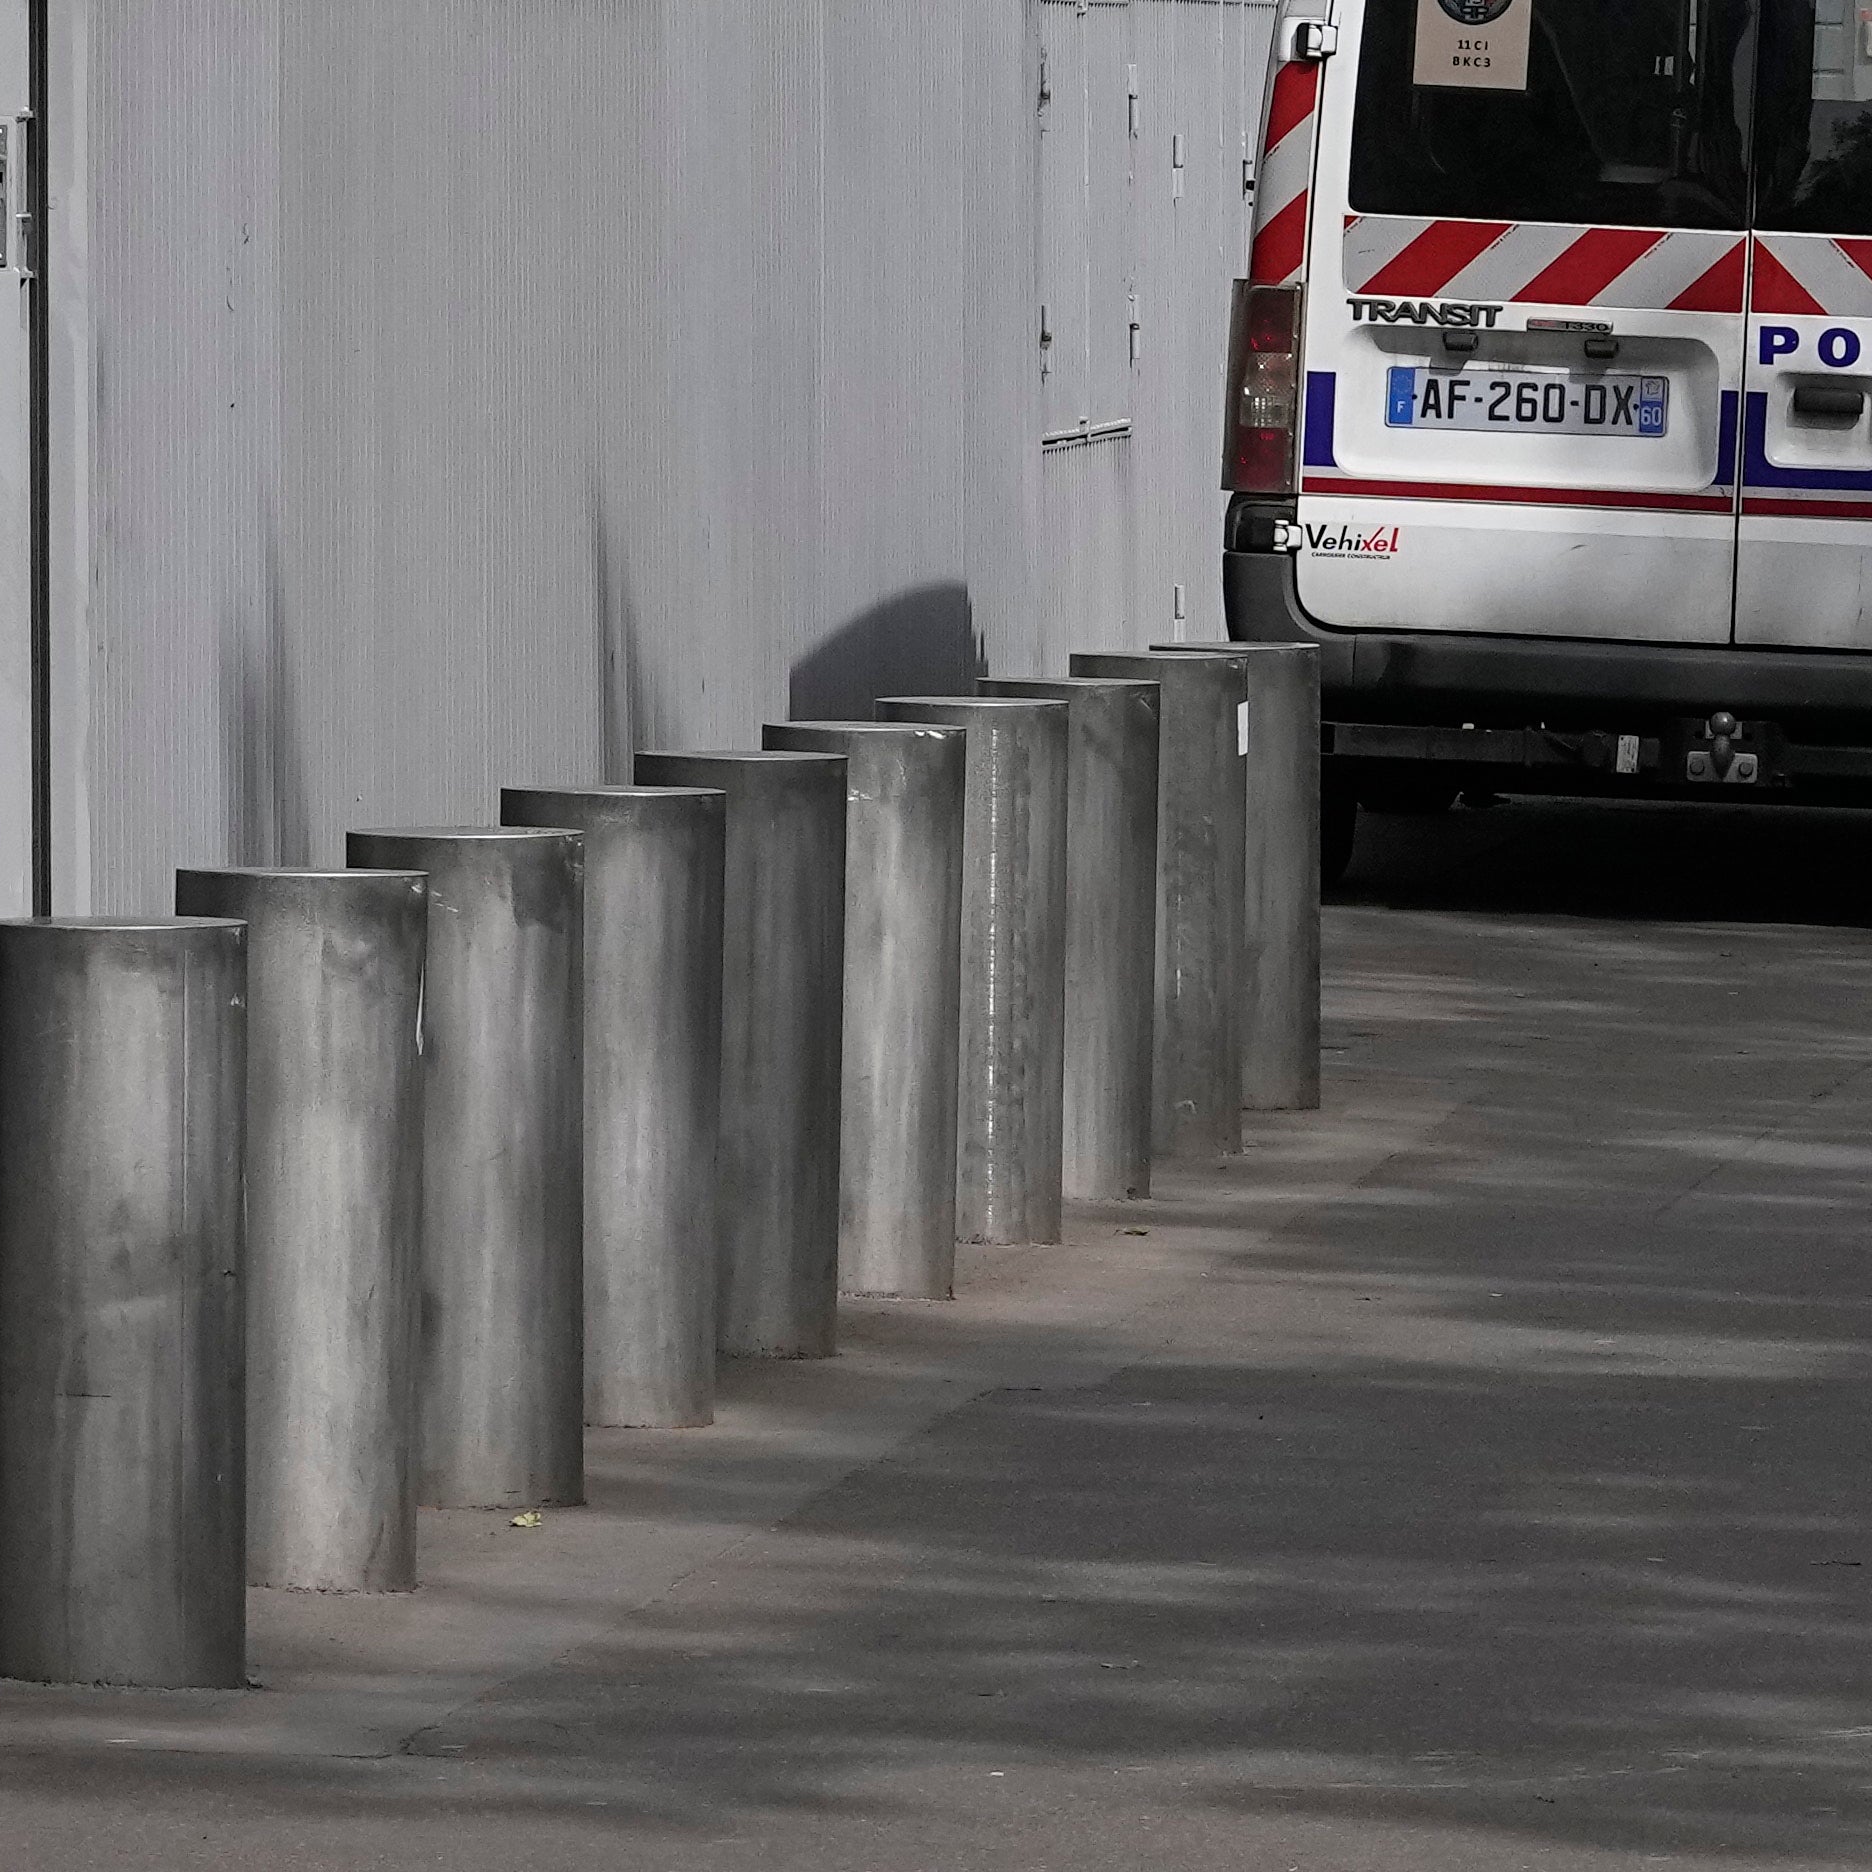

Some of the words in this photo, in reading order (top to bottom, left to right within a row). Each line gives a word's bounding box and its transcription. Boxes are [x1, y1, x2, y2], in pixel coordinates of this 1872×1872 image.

[1346, 298, 1504, 328] TRANSIT
[1396, 400, 1407, 414] F
[1419, 378, 1635, 426] AF-260-DX
[1640, 405, 1663, 427] 60
[1305, 523, 1401, 553] Vehixel
